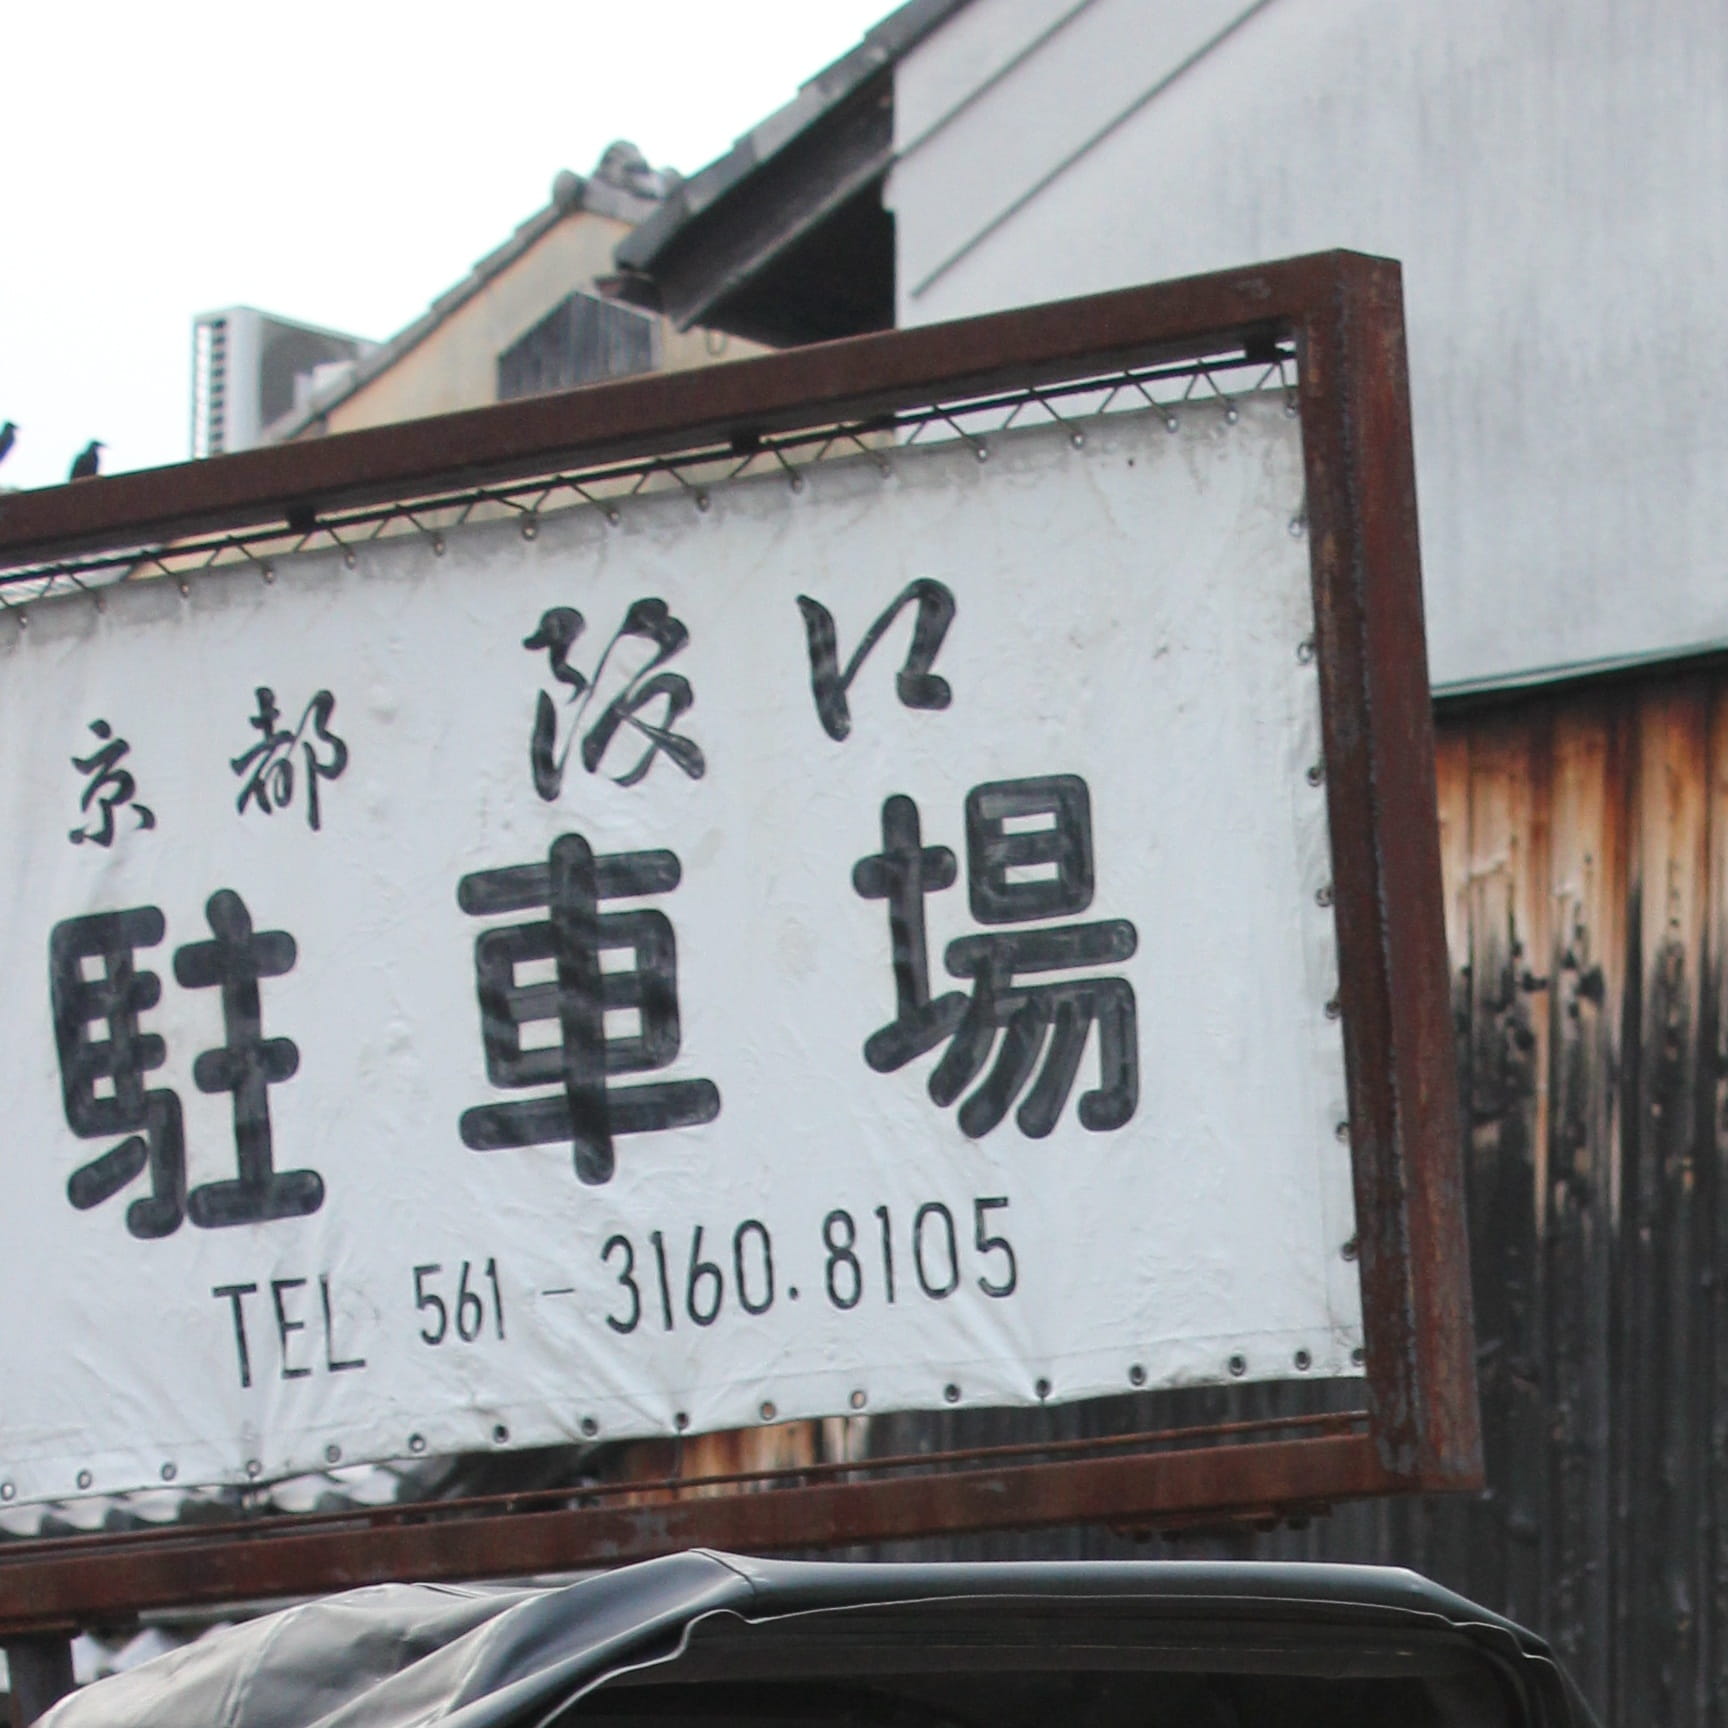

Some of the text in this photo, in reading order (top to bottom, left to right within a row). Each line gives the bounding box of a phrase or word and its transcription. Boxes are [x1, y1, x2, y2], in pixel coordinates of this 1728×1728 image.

[69, 687, 348, 847] 京都
[50, 773, 1138, 1239] 駐車場
[213, 1278, 366, 1389] TEL
